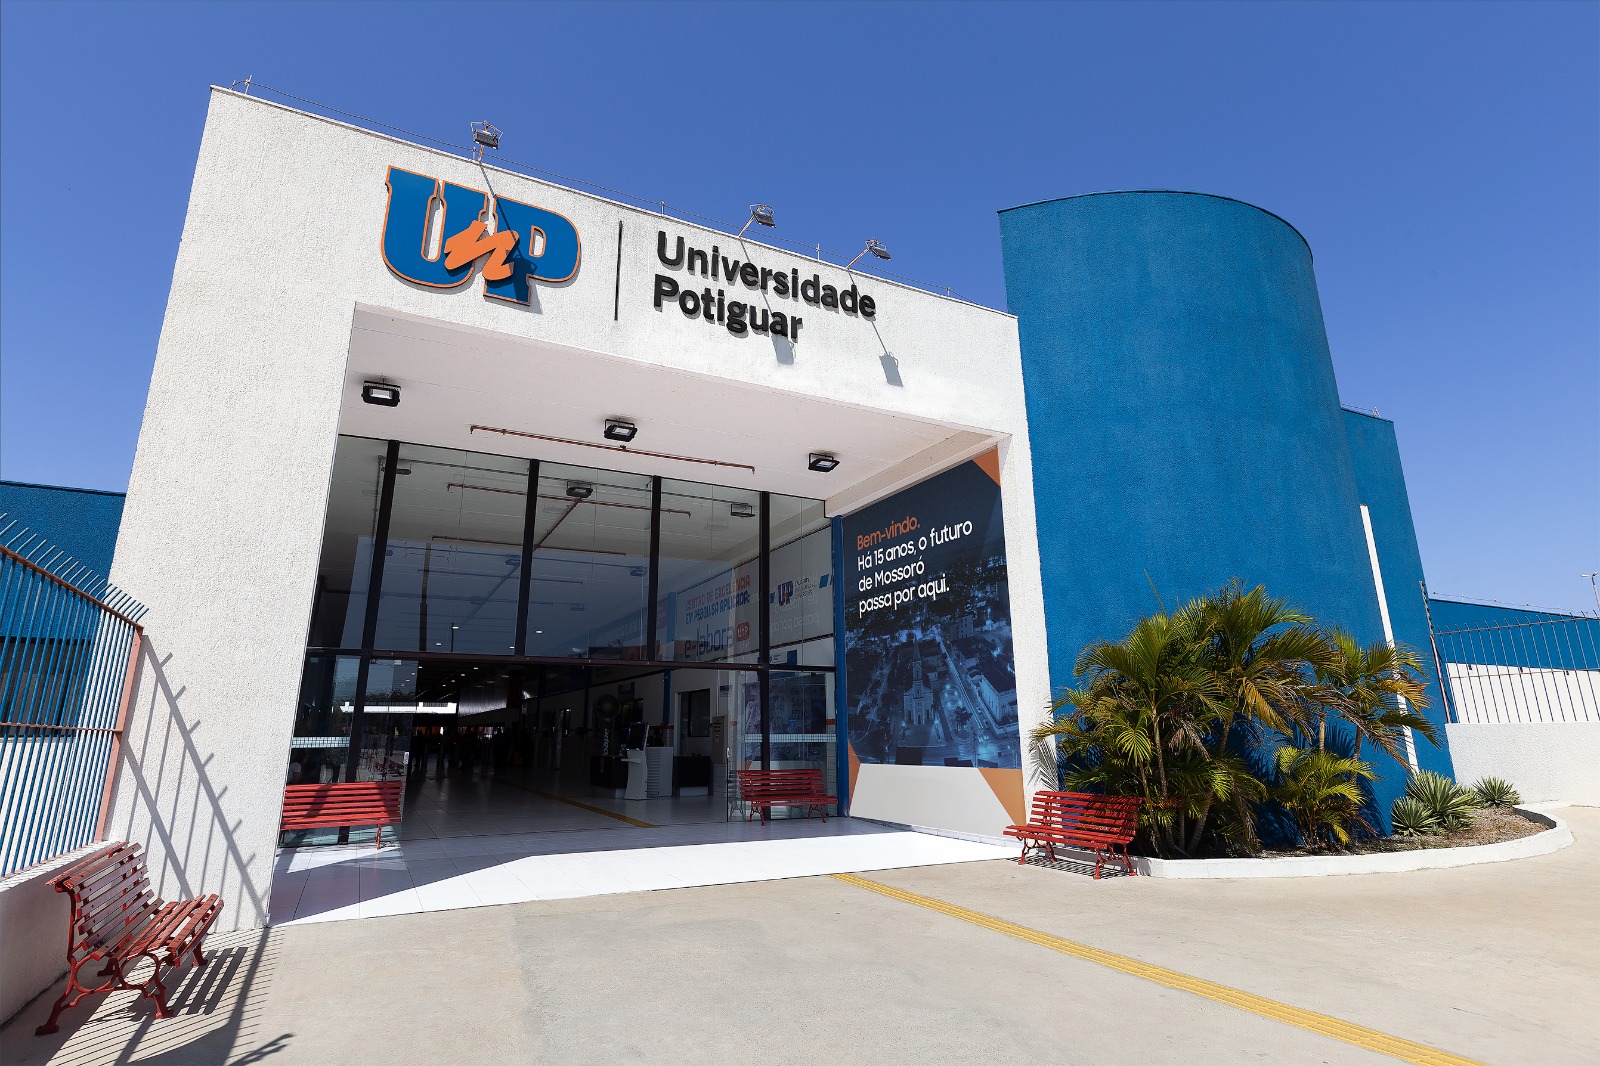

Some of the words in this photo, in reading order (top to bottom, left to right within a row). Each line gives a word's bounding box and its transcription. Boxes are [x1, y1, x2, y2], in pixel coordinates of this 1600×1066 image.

[657, 230, 877, 320] Universidade
[653, 274, 803, 340] Potiguar
[857, 516, 920, 551] Bem-vindo.
[857, 551, 873, 571] Há
[874, 548, 884, 566] 15
[885, 540, 917, 562] anos,
[918, 537, 928, 550] o
[930, 520, 973, 547] futuro
[858, 575, 873, 592] de
[874, 555, 925, 587] Mossoró
[859, 592, 892, 618] passa
[894, 586, 915, 610] por
[917, 573, 950, 600] aqui.
